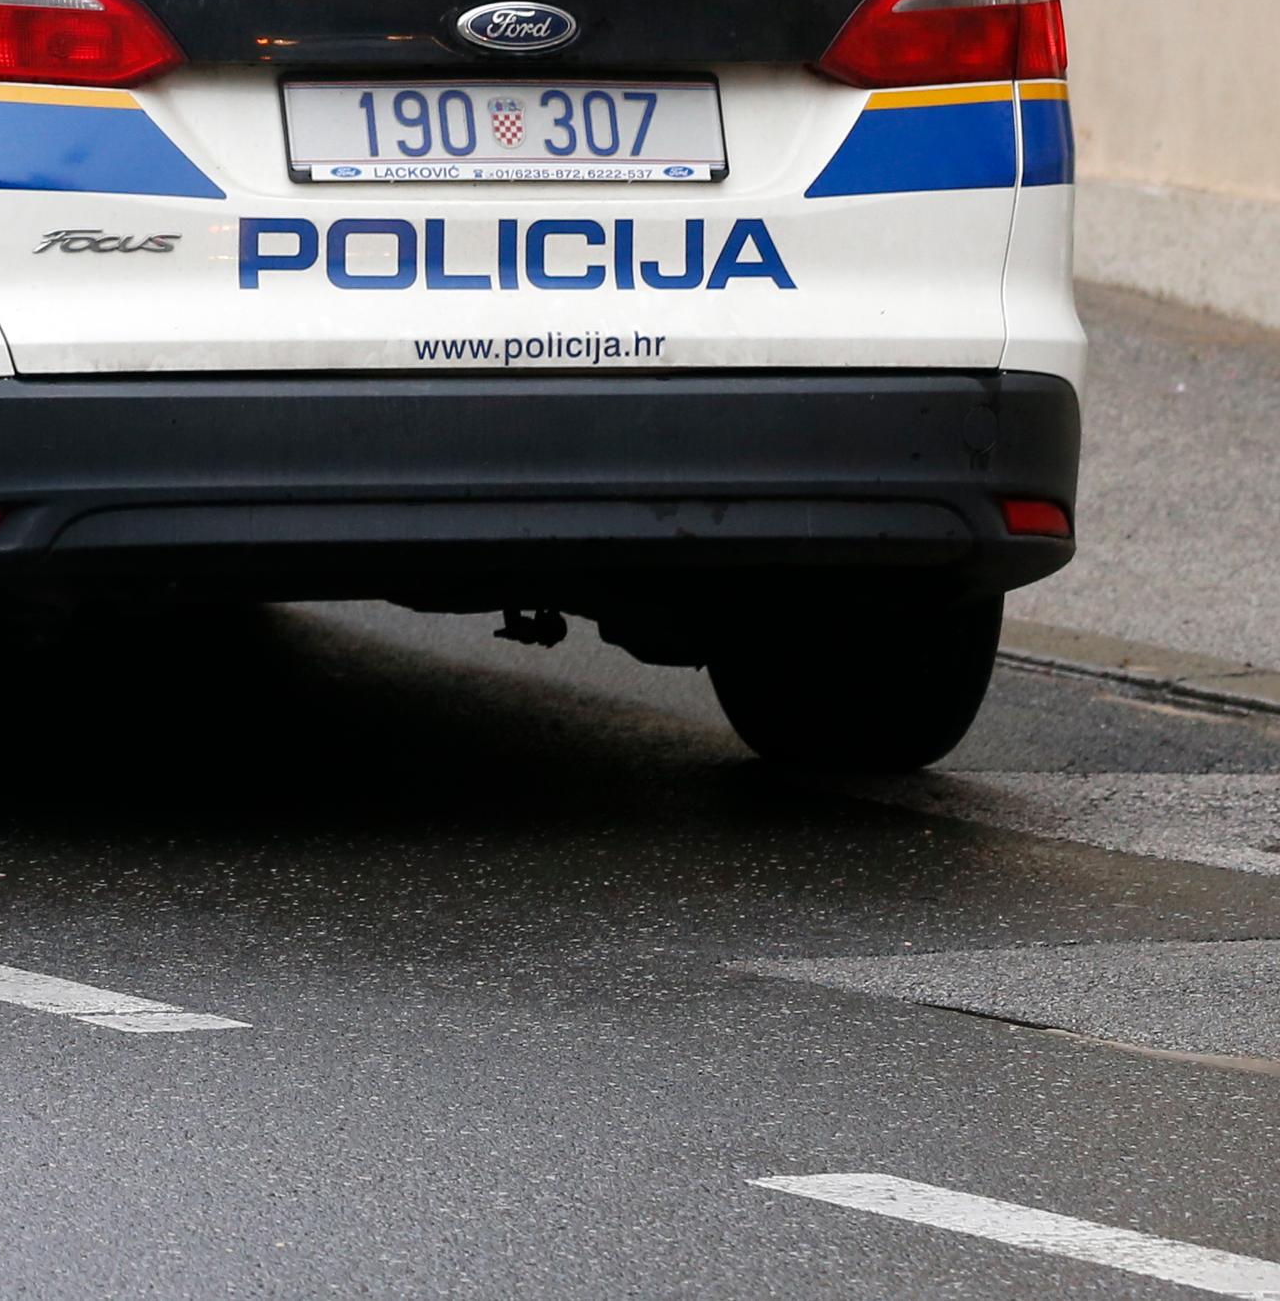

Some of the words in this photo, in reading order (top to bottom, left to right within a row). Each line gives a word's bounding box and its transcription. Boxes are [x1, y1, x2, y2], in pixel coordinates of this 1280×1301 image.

[486, 9, 553, 38] Ford
[359, 90, 478, 158] 190
[540, 90, 658, 158] 307
[373, 165, 461, 179] LACKOVIĆ
[239, 218, 799, 290] POLICIJA
[415, 331, 666, 367] www.policija.hr
